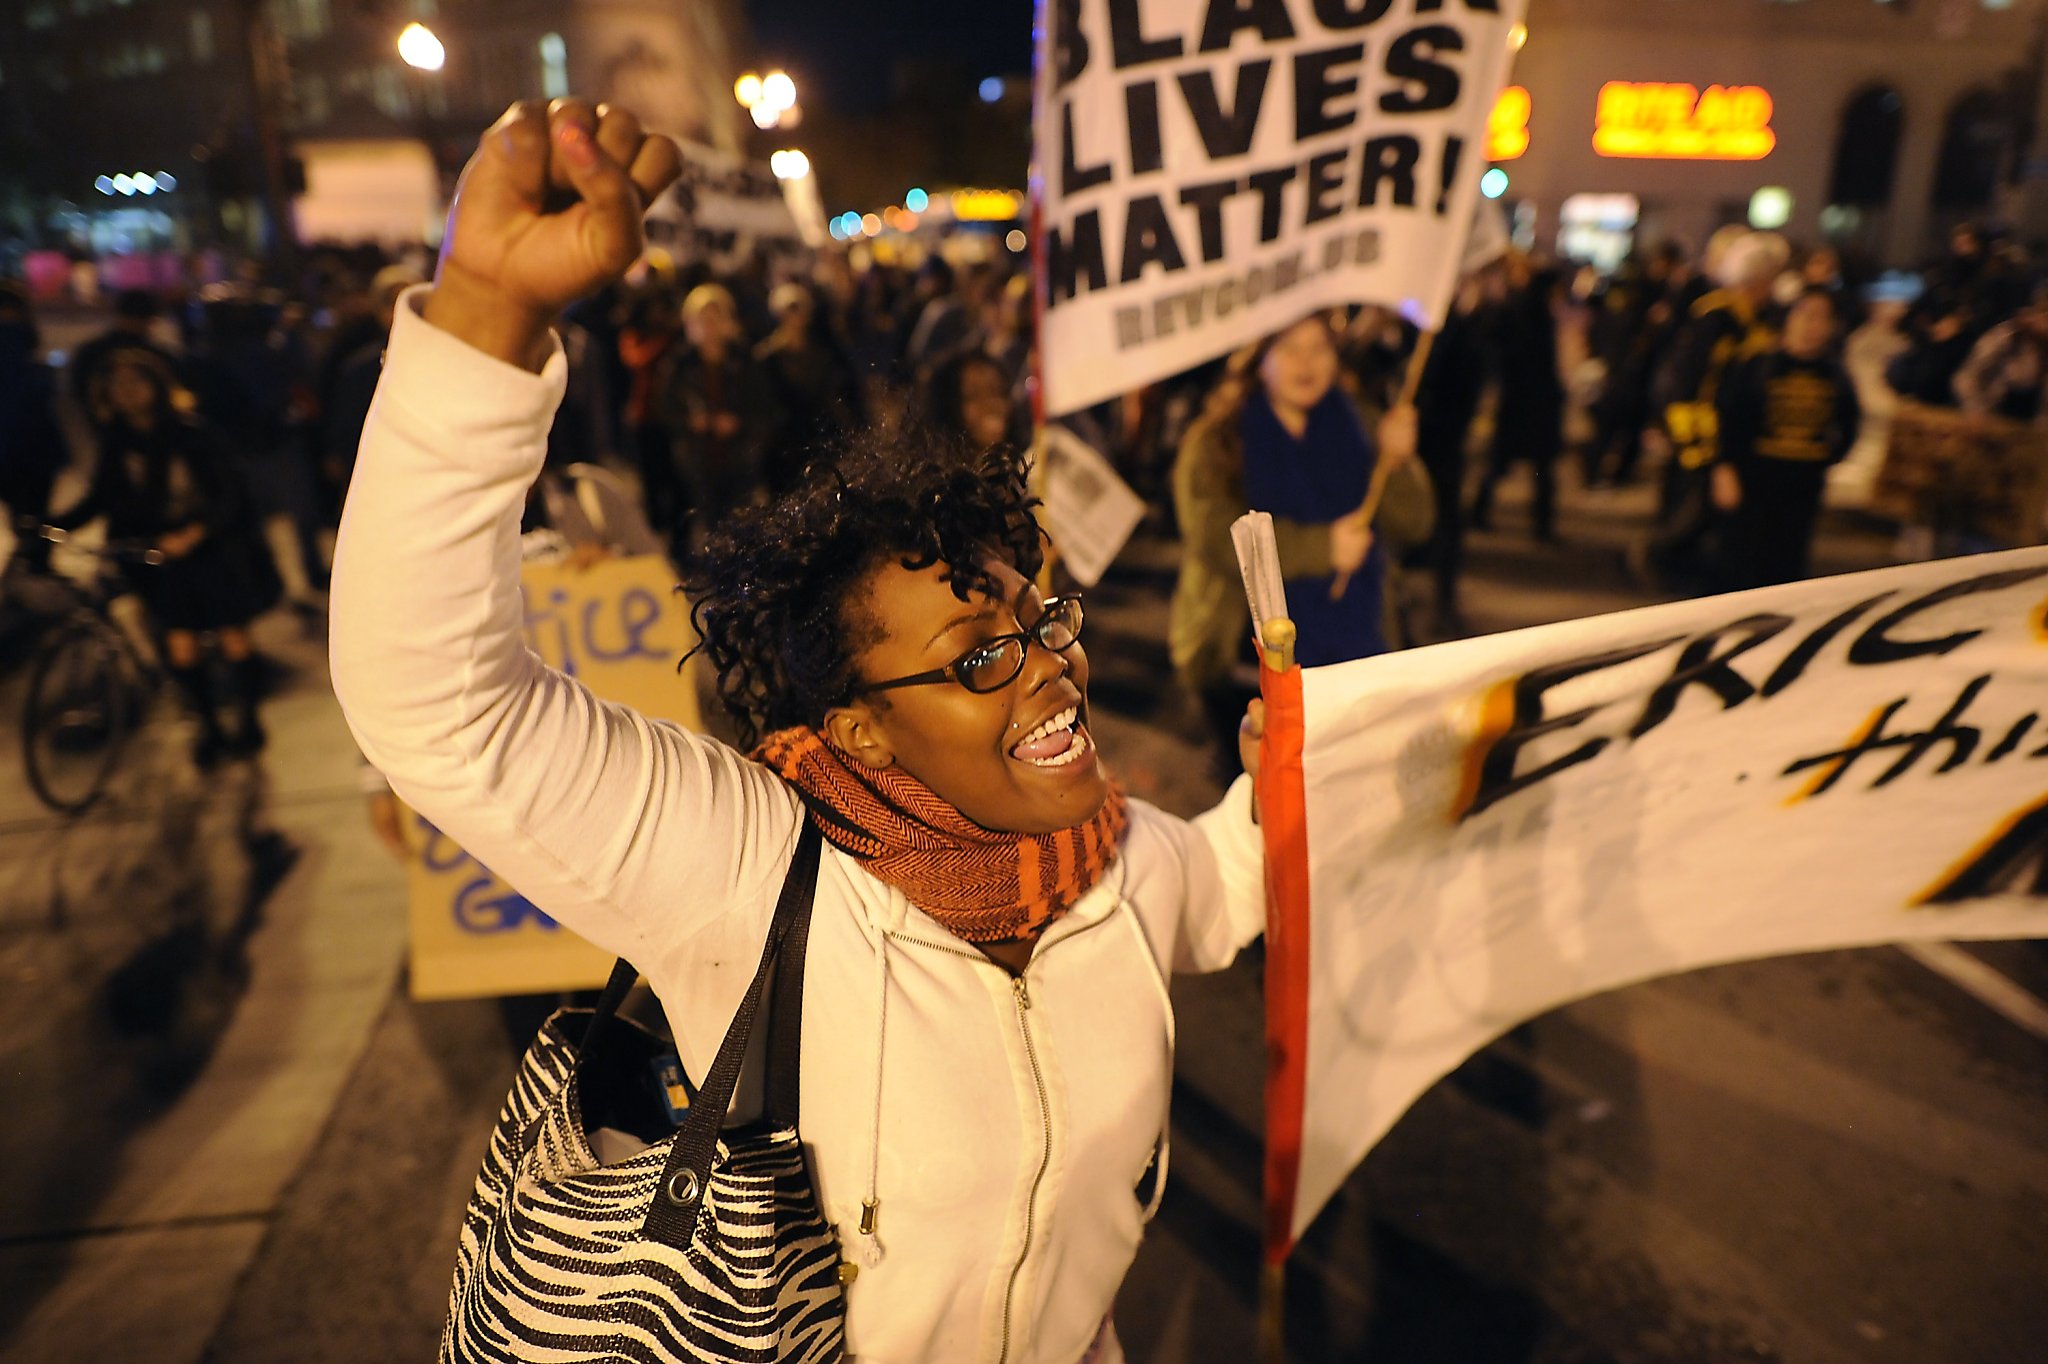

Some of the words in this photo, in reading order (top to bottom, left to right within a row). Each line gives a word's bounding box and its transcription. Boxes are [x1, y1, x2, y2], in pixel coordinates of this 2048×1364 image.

[1053, 0, 1499, 92] BLA
[1061, 25, 1464, 197] LIVES
[1047, 134, 1467, 307] MATTER!
[1452, 566, 2048, 827] ERIC
[1781, 672, 2048, 799] thi
